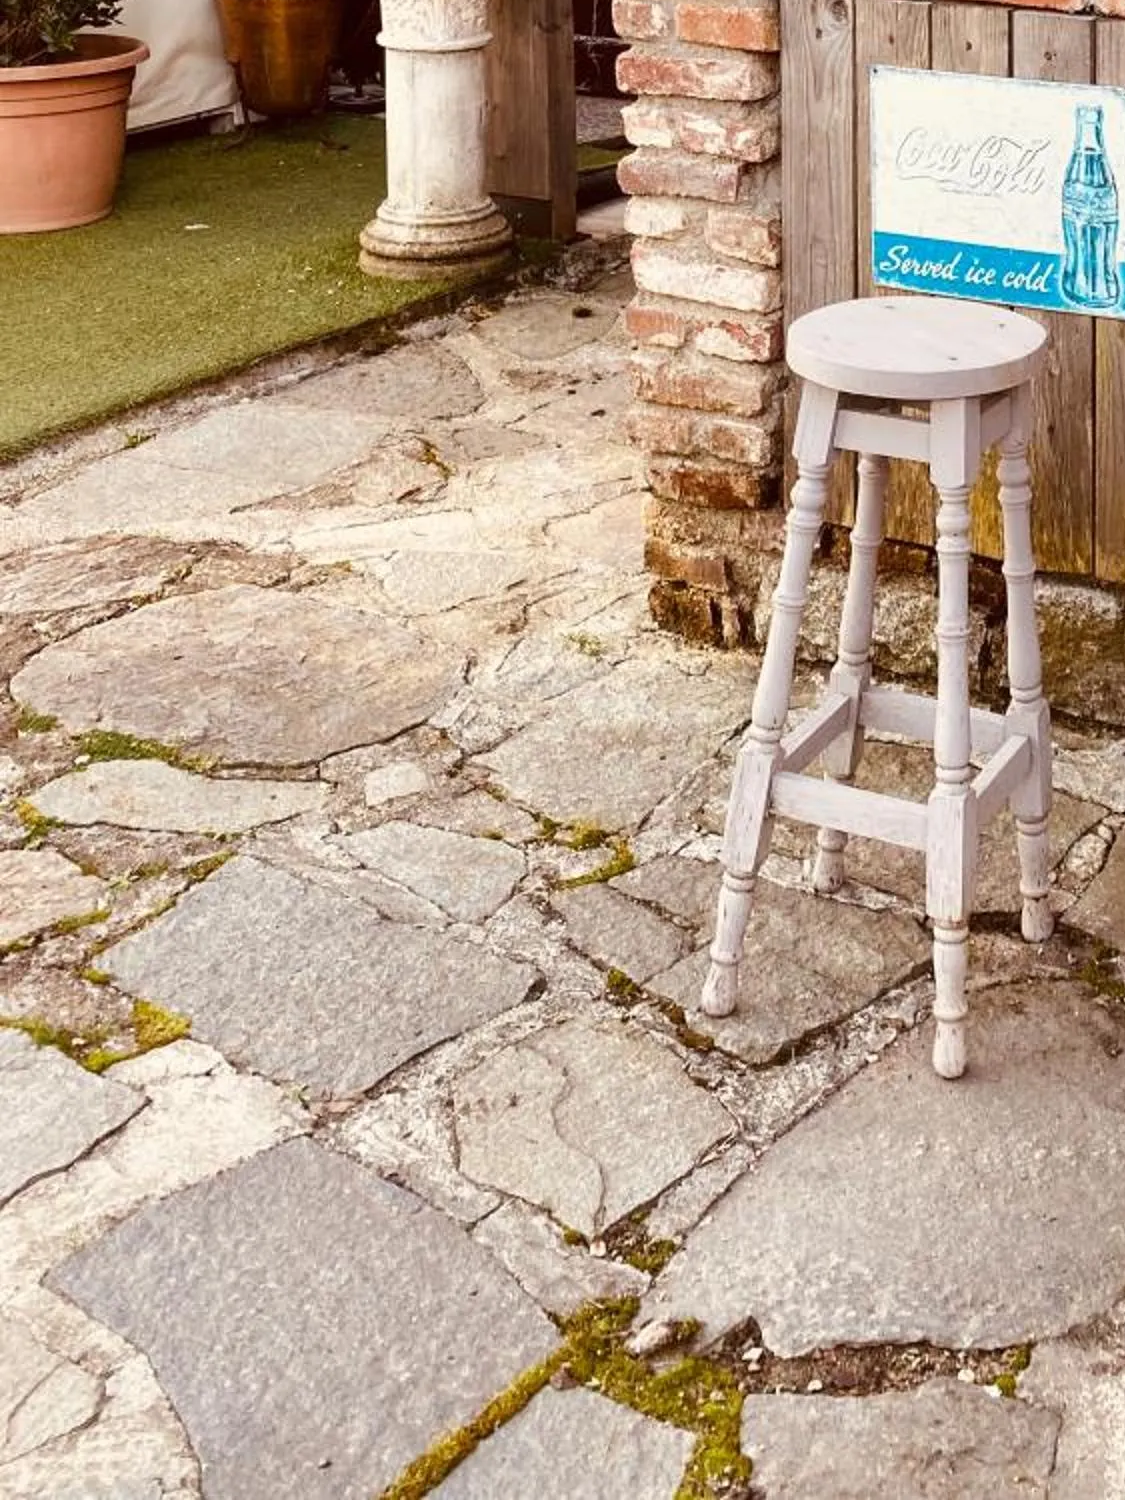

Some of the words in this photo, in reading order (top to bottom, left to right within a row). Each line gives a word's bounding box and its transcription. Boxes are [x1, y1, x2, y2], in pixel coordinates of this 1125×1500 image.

[880, 246, 960, 280] Served
[965, 259, 997, 285] ice
[1002, 263, 1054, 293] cold
